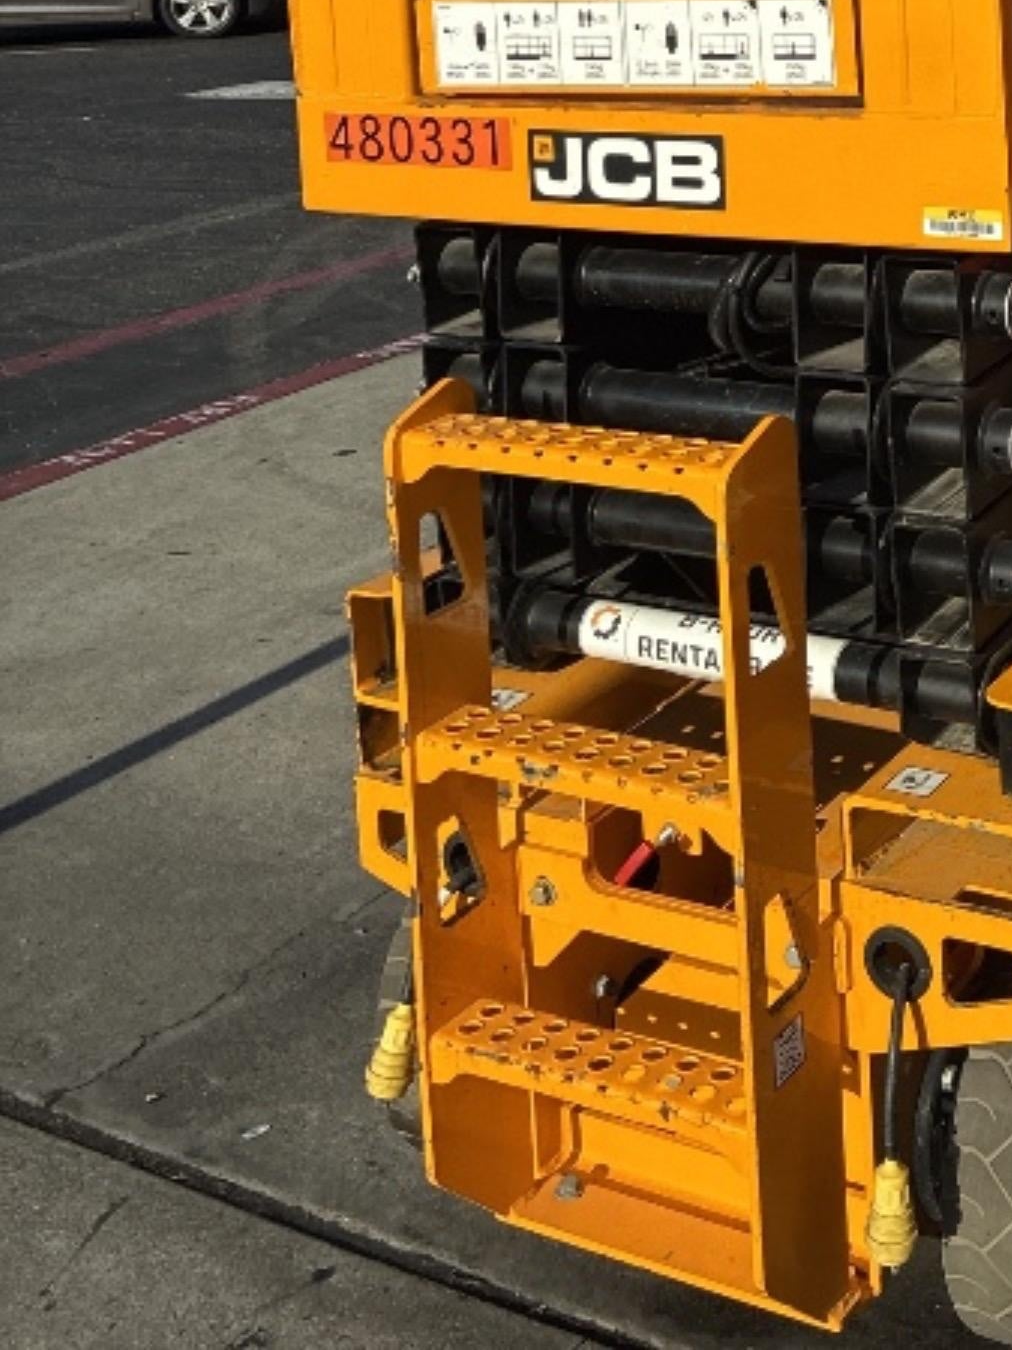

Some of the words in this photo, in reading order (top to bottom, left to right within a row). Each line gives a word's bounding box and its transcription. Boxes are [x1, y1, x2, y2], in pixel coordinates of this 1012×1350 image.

[328, 113, 500, 167] 480331
[533, 136, 722, 205] JCB
[637, 635, 721, 673] RENTA
